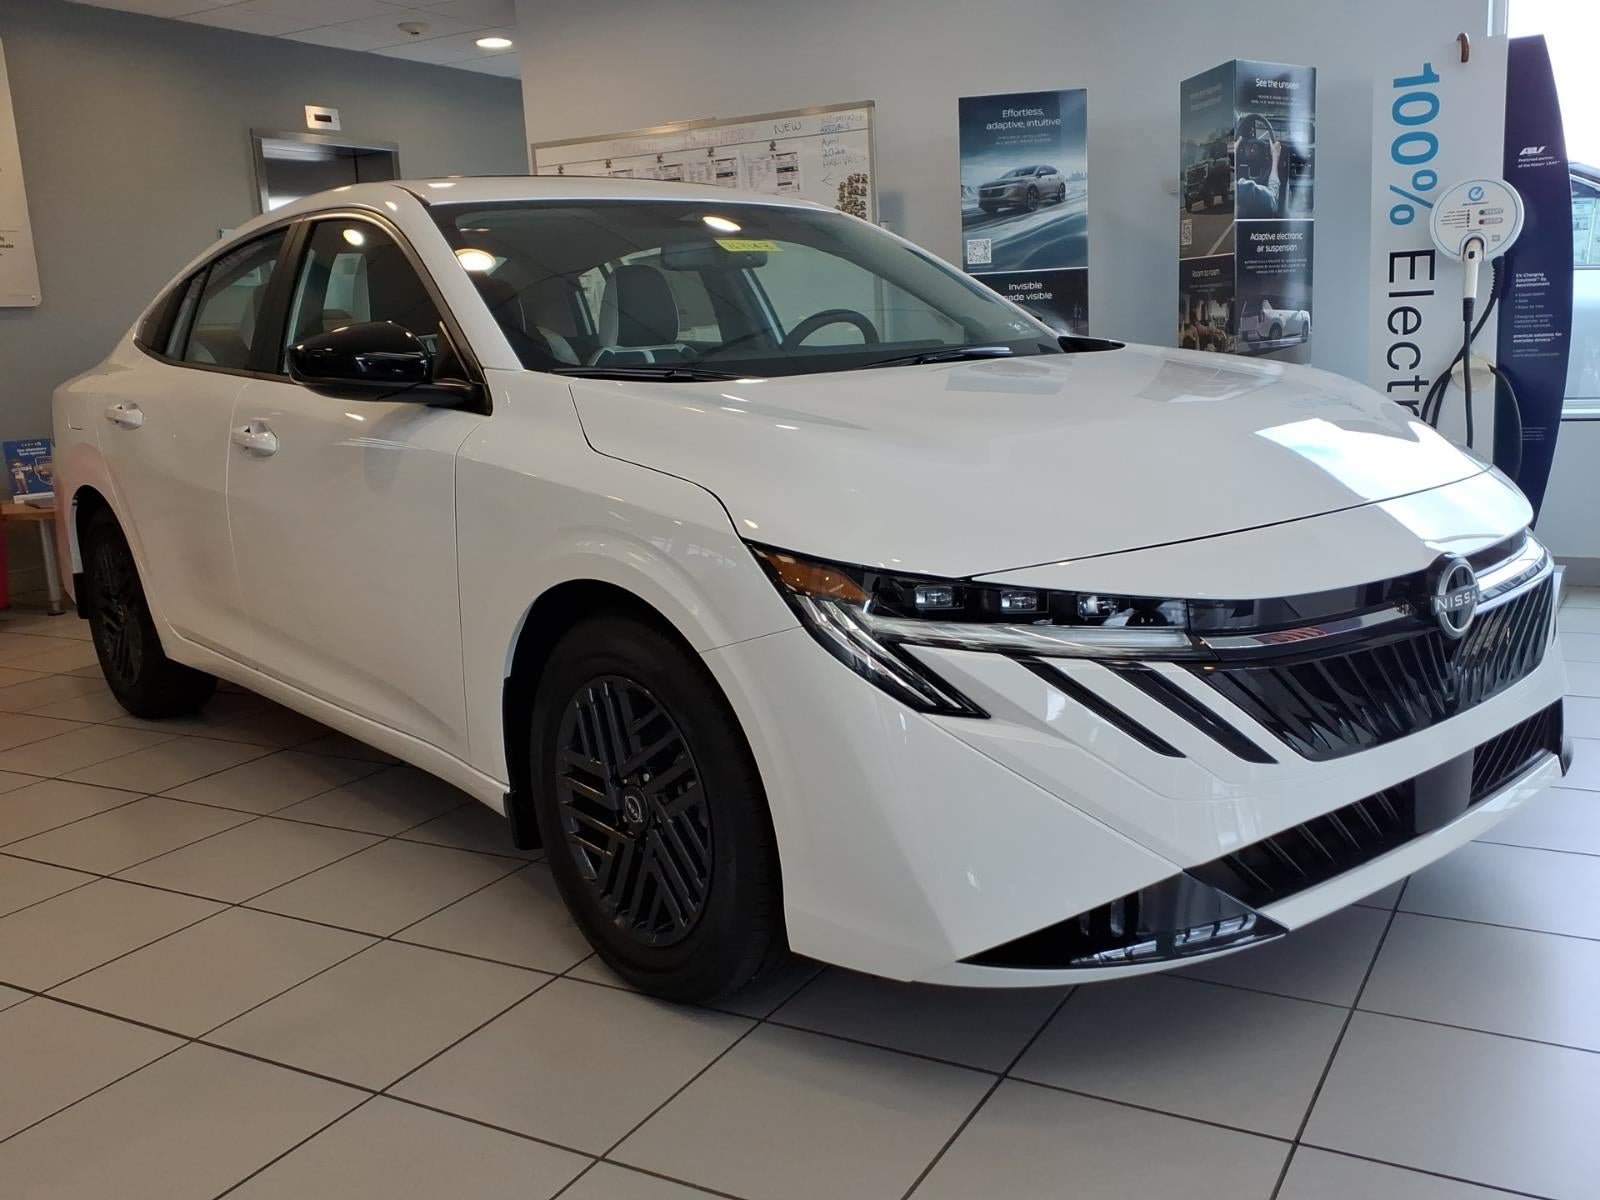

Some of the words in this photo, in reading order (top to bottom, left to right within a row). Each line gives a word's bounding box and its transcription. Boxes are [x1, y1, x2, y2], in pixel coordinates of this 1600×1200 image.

[1255, 78, 1267, 88] See
[1267, 79, 1278, 89] the
[1002, 108, 1045, 119] Effortless,
[773, 121, 802, 135] NEW
[986, 120, 1026, 131] adaptive,
[1026, 117, 1061, 128] intuitive
[1389, 62, 1441, 226] 100%
[1250, 232, 1276, 242] Adaptive
[1276, 231, 1303, 241] electronic
[1256, 244, 1264, 253] air
[1265, 243, 1298, 254] suspension
[1008, 281, 1043, 291] Invisible
[1025, 290, 1053, 300] visible
